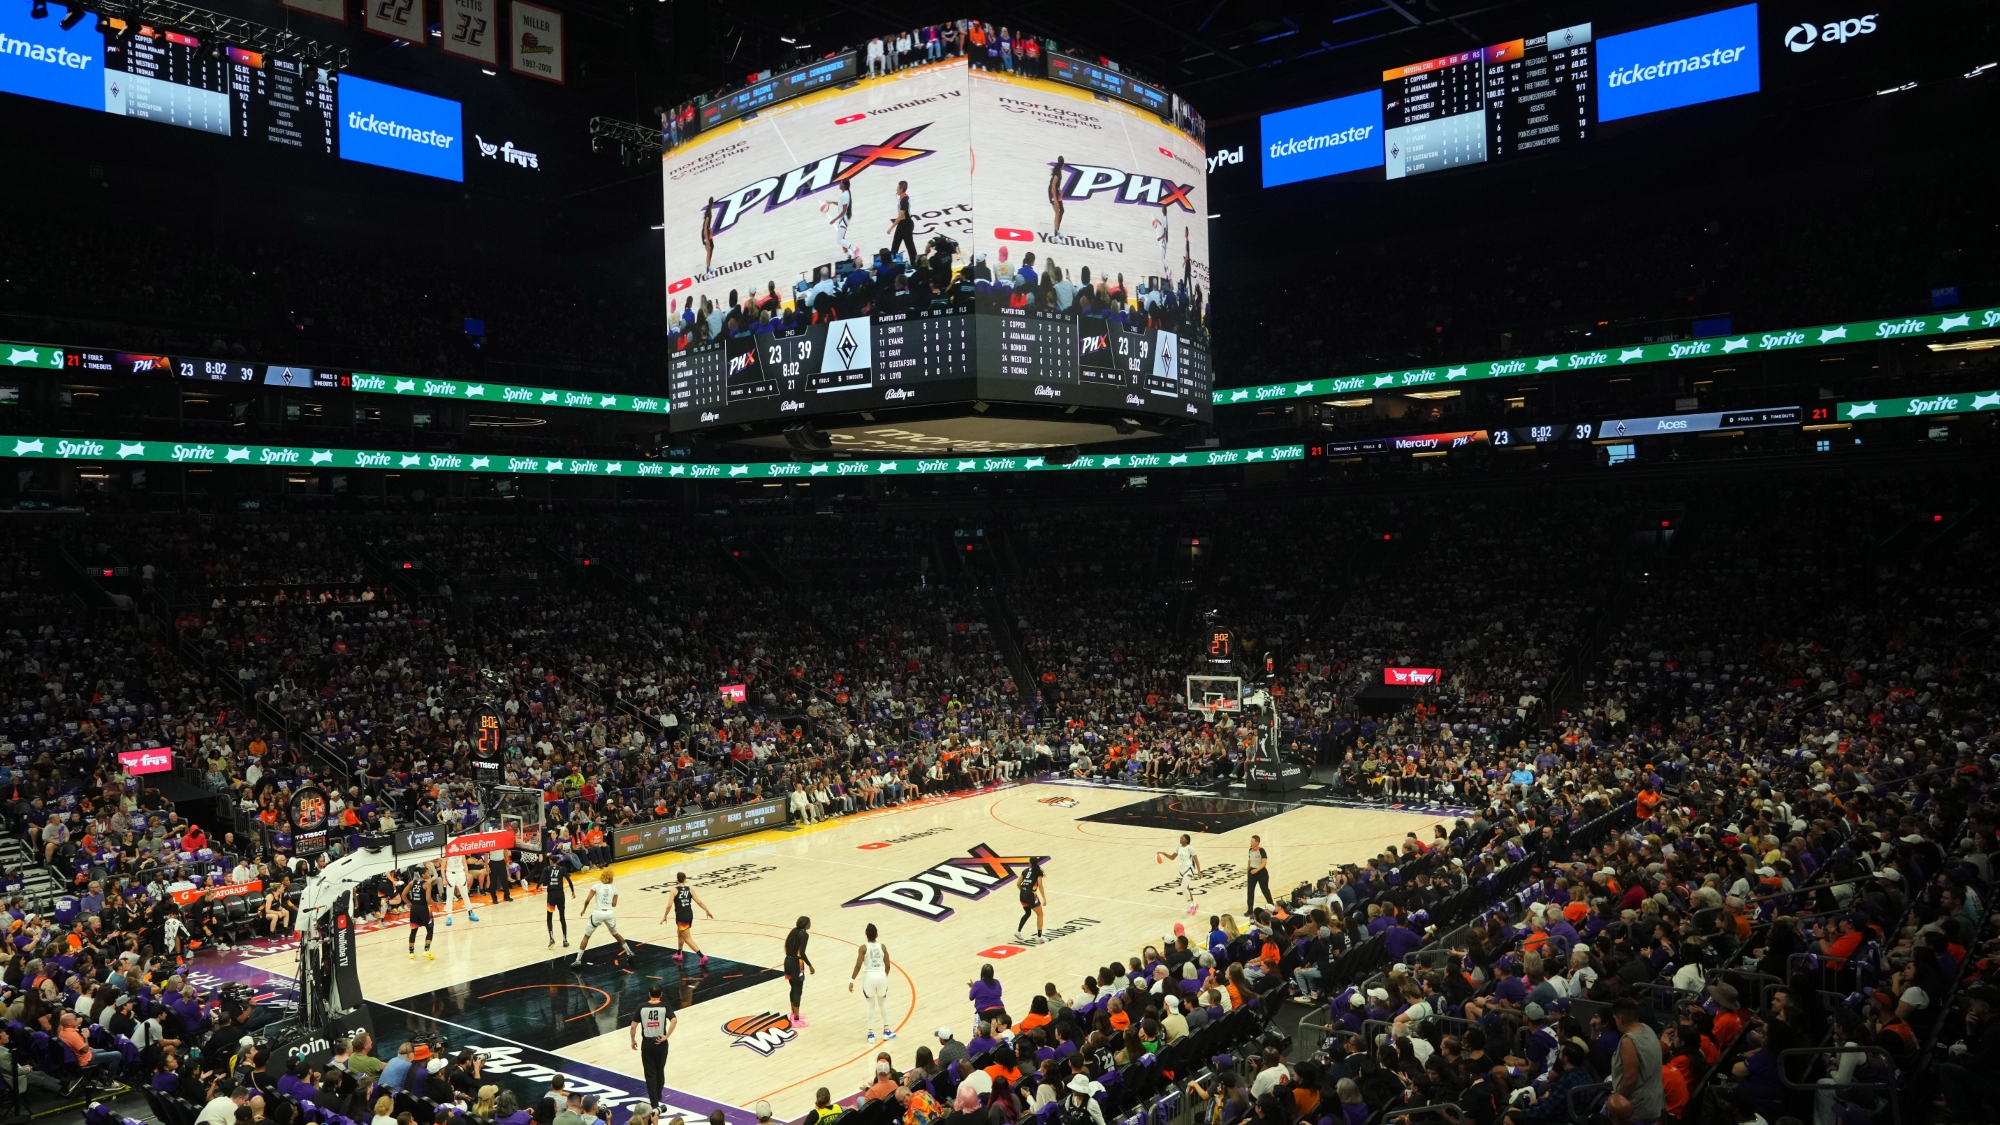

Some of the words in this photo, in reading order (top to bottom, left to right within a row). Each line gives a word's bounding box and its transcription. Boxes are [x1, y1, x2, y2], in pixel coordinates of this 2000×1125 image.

[376, 0, 412, 26] 22
[452, 12, 487, 47] 32
[523, 14, 551, 33] MILLER
[1822, 14, 1877, 44] aps
[1488, 65, 1504, 75] 45.0%
[1570, 47, 1588, 57] 58.3%
[1607, 45, 1746, 89] ticketmaster
[1489, 76, 1505, 87] 16.7%
[1571, 58, 1588, 69] 60.0%
[1486, 88, 1505, 99] 100.0%
[1571, 70, 1588, 80] 71.4%
[867, 95, 939, 117] YouTube
[940, 90, 962, 104] TV
[999, 97, 1100, 123] mortgage
[1411, 101, 1435, 112] WESTBELD
[1493, 100, 1503, 109] 9/2
[1031, 109, 1102, 130] matchup
[1037, 117, 1078, 129] center
[1411, 112, 1430, 122] THOMAS
[1578, 119, 1587, 127] 10
[347, 110, 454, 149] ticketmaster
[1269, 124, 1373, 159] ticketmaster
[500, 141, 540, 170] fry's
[669, 140, 747, 176] mortgage
[689, 145, 750, 173] matchup
[1205, 145, 1244, 174] yPal
[693, 160, 725, 176] center
[700, 121, 938, 238] PHX
[1048, 162, 1196, 213] PHX
[1037, 231, 1105, 251] YouTube
[1105, 240, 1124, 254] TV
[753, 250, 775, 264] TV
[879, 315, 894, 323] PLAYER
[1009, 320, 1026, 329] COPPER
[888, 325, 903, 334] SMITH
[1876, 319, 1925, 338] Sprite
[888, 337, 904, 346] EVANS
[1081, 334, 1108, 356] PHX
[1118, 336, 1129, 355] 23
[1139, 341, 1149, 358] 39
[1759, 330, 1805, 349] Sprite
[769, 345, 782, 364] 23
[798, 340, 812, 360] 39
[888, 349, 901, 357] GRAY
[1667, 341, 1711, 359] Sprite
[67, 354, 80, 367] 21
[87, 354, 104, 362] FOULS
[131, 357, 163, 374] PHX
[728, 348, 755, 378] PHX
[889, 358, 917, 368] GUSTAFSON
[1010, 355, 1032, 364] WESTBELD
[1128, 357, 1141, 372] 8:02
[1567, 351, 1608, 369] Sprite
[88, 362, 112, 371] TIMEOUTS
[180, 363, 194, 377] 23
[205, 361, 227, 375] 8:02
[240, 367, 253, 381] 39
[782, 362, 800, 377] 8:02
[1010, 367, 1028, 375] THOMAS
[1488, 359, 1526, 377] Sprite
[341, 376, 350, 387] 21
[351, 374, 386, 392] Sprite
[889, 372, 902, 380] LOYD
[1132, 375, 1138, 384] 21
[1401, 369, 1437, 386] Sprite
[422, 380, 456, 397] Sprite
[788, 380, 795, 389] 21
[1034, 385, 1055, 398] Bally
[1332, 376, 1365, 393] Sprite
[502, 387, 533, 402] Sprite
[564, 392, 593, 407] Sprite
[885, 388, 907, 400] Bally
[1255, 384, 1287, 401] Sprite
[631, 397, 658, 412] Sprite
[781, 400, 799, 412] Bally
[1906, 396, 1958, 416] Sprite
[1812, 408, 1828, 419] 21
[1657, 420, 1688, 430] Aces
[1452, 432, 1478, 449] PHX
[1494, 431, 1508, 445] 23
[1531, 426, 1552, 438] 8:02
[1576, 424, 1592, 439] 39
[55, 440, 104, 459] Sprite
[1311, 446, 1322, 456] 21
[1395, 438, 1438, 450] Mercury
[171, 444, 215, 462] Sprite
[259, 447, 300, 464] Sprite
[354, 452, 391, 468] Sprite
[1207, 450, 1239, 465] Sprite
[1270, 446, 1302, 460] Sprite
[428, 454, 461, 470] Sprite
[507, 457, 538, 473] Sprite
[569, 460, 598, 475] Sprite
[836, 461, 869, 476] Sprite
[916, 459, 949, 474] Sprite
[983, 457, 1016, 472] Sprite
[1062, 456, 1095, 470] rite
[1128, 454, 1160, 468] Sprite
[637, 463, 663, 477] Sprite
[690, 464, 721, 478] Sprite
[768, 463, 801, 477] Sprite
[1214, 633, 1228, 641] 8:02
[1211, 641, 1228, 654] 21
[481, 715, 498, 729] 8:02
[478, 728, 499, 750] 21
[479, 761, 499, 770] TISSOT
[727, 813, 742, 823] BEARS
[745, 805, 776, 819] COMMANDERS
[304, 829, 327, 839] TISSOT
[668, 824, 682, 834] BILLS
[685, 819, 706, 831] FALCONS
[414, 831, 434, 839] WNBA
[414, 836, 435, 845] APP
[619, 834, 639, 845] ESPN
[550, 869, 559, 877] 14
[412, 884, 421, 892] 25
[841, 842, 1052, 922] PHX
[181, 891, 189, 900] G
[678, 890, 689, 899] 24
[339, 928, 348, 957] YouTube
[339, 957, 349, 967] TV
[648, 1010, 659, 1021] 42
[1102, 1052, 1114, 1069] 22
